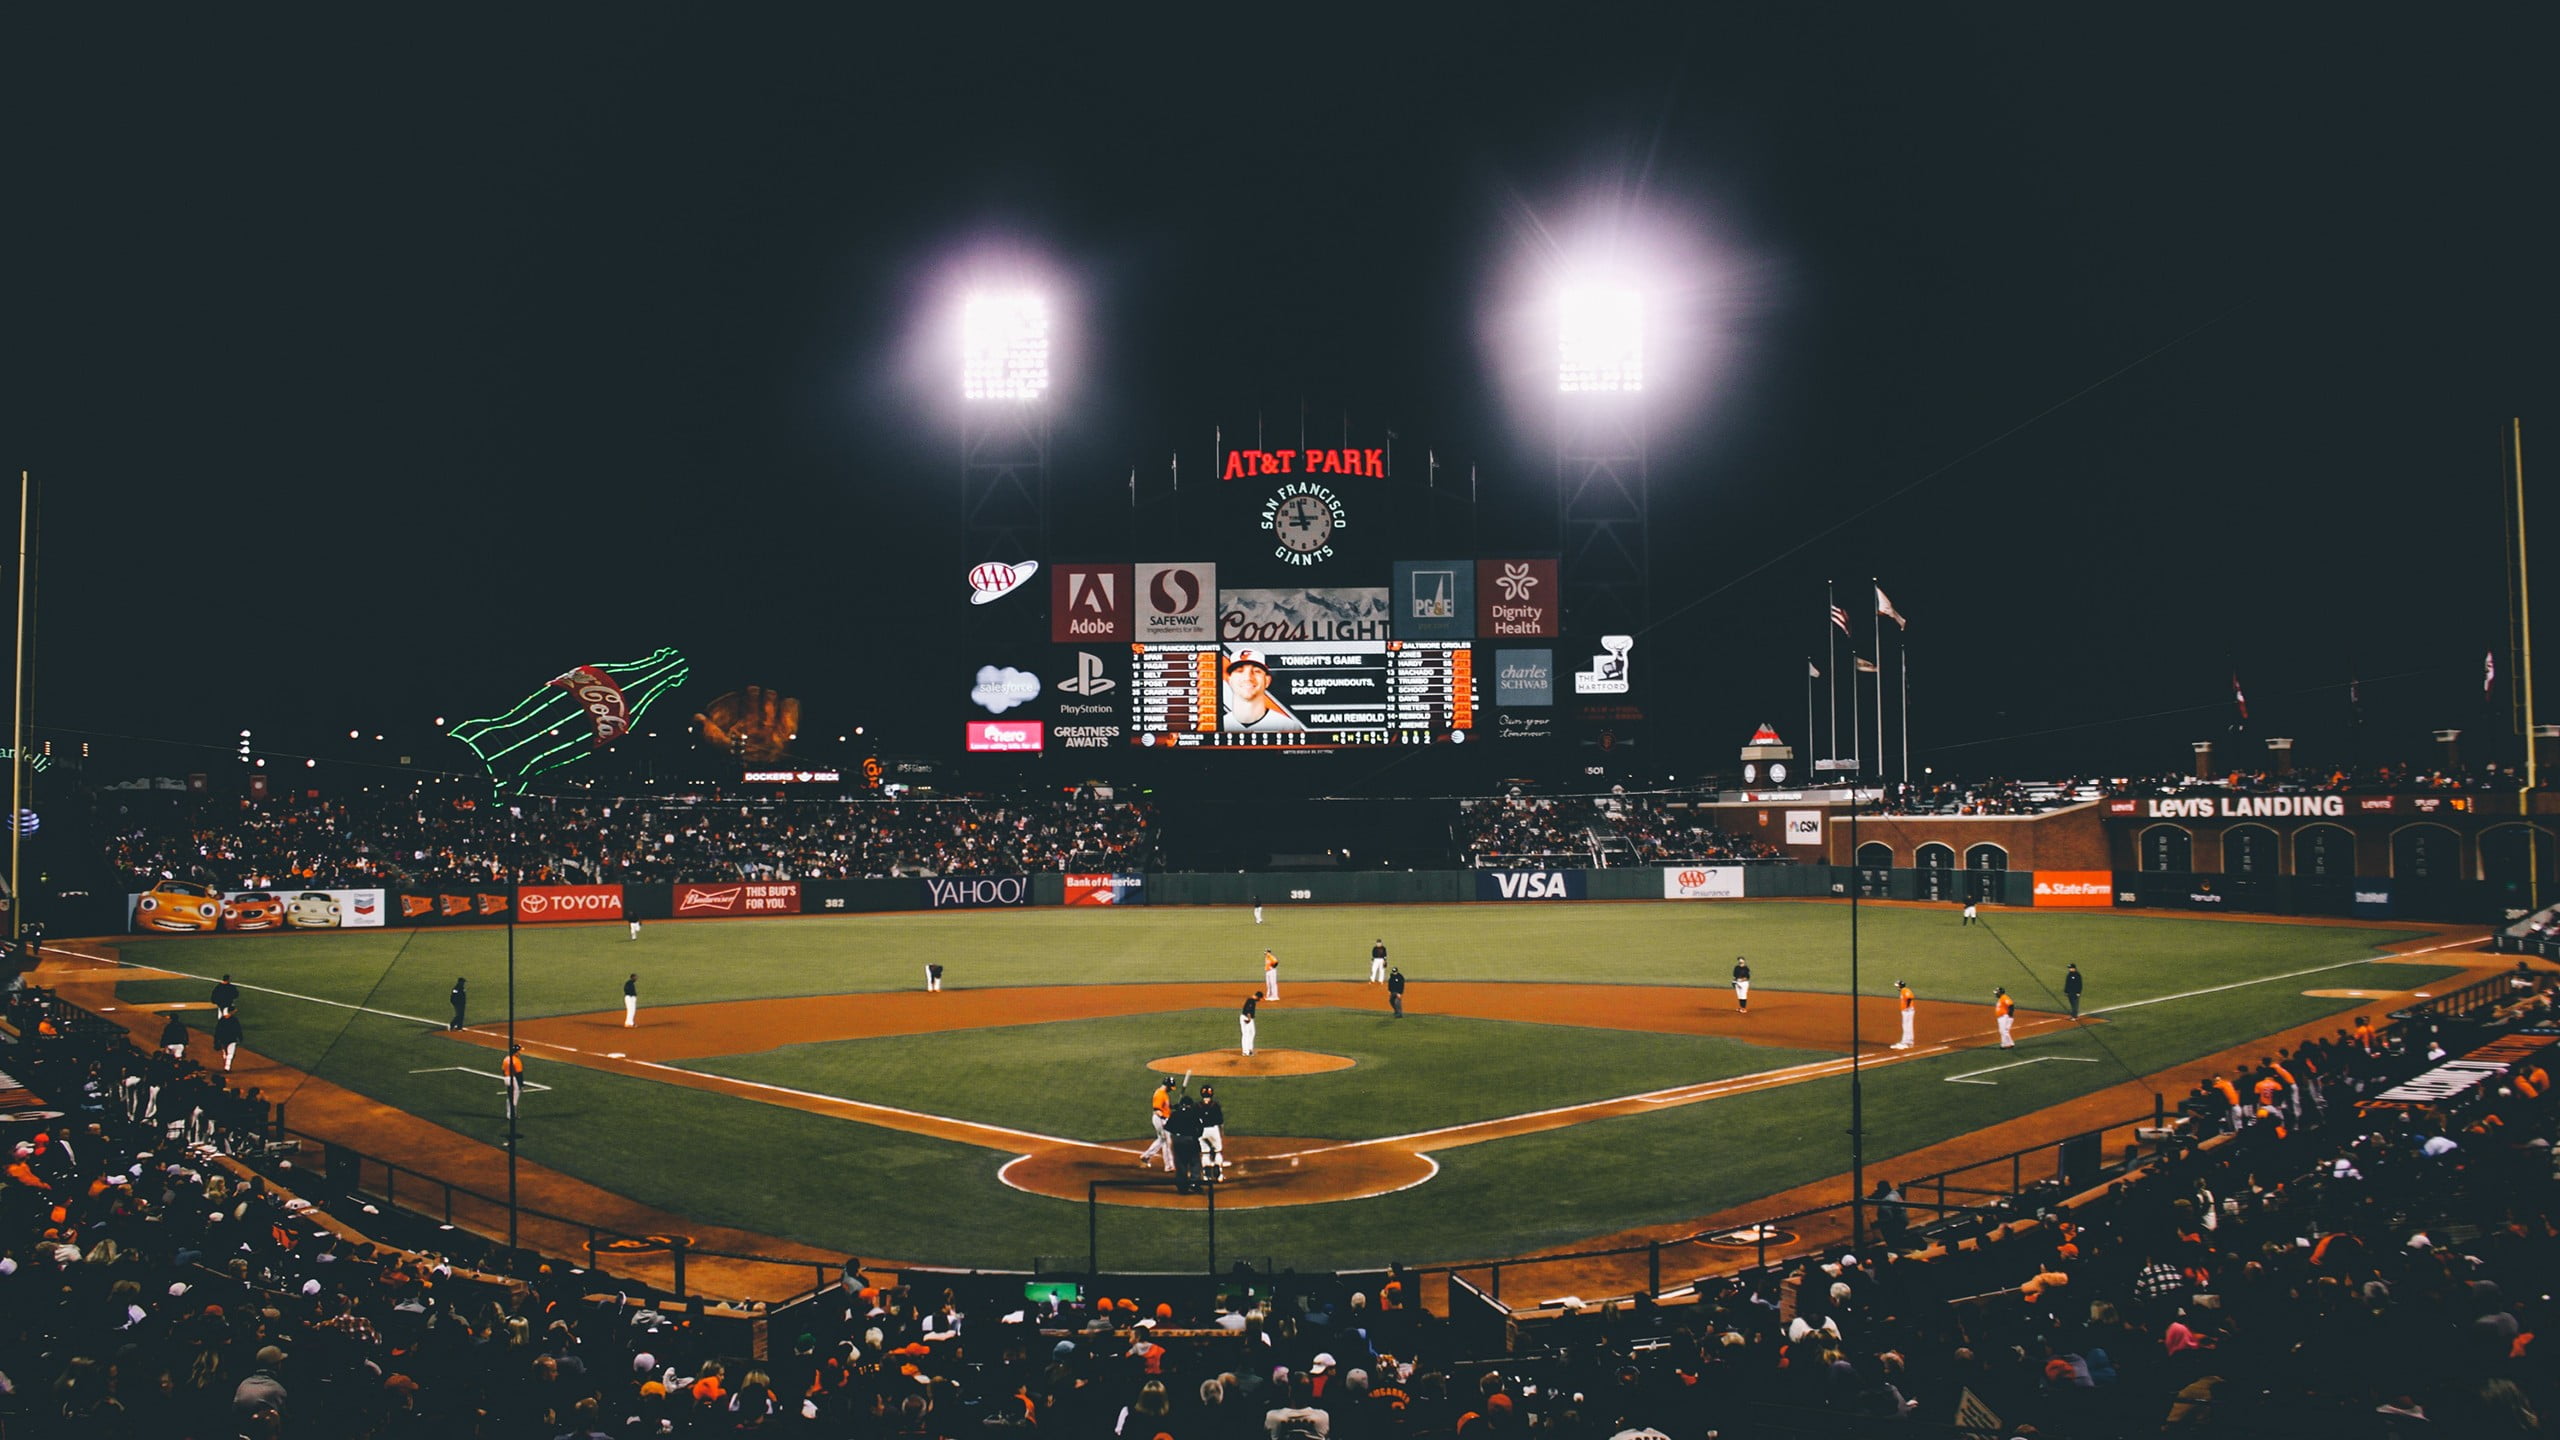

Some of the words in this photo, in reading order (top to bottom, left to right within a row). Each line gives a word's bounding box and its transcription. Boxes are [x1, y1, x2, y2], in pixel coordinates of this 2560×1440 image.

[1223, 449, 1297, 480] AT&T
[1304, 448, 1385, 479] PARK
[1261, 497, 1279, 529] SAN
[1277, 481, 1346, 528] FRANCISCO
[1275, 545, 1334, 565] GIANTS
[976, 564, 1013, 592] AAA
[1415, 599, 1452, 617] PG&E
[1492, 605, 1542, 621] Dignity
[1069, 618, 1114, 634] Adobe
[1150, 616, 1199, 626] SAFEWAY
[1222, 611, 1308, 640] Coors
[1313, 621, 1390, 640] LIGHT
[1495, 621, 1540, 634] Health
[1280, 656, 1331, 665] TONIGHT'S
[1333, 655, 1362, 665] GAME
[1501, 665, 1546, 679] charles
[980, 681, 1033, 695] salesforce
[1314, 678, 1375, 687] GROUNDOUTS,
[1501, 679, 1548, 689] SCHWAB
[1291, 687, 1326, 695] POPOUT
[579, 685, 628, 739] Cola
[1060, 704, 1112, 715] PlayStation
[1310, 714, 1342, 722] NOLAN
[1344, 713, 1384, 722] REIMOLD
[1054, 726, 1119, 737] GREATNESS
[1065, 737, 1109, 748] AWAITS
[745, 772, 794, 781] DOCKERS
[813, 772, 839, 781] DECK
[2221, 796, 2344, 817] LANDING
[1800, 821, 1818, 832] CSN
[1067, 877, 1091, 887] Bank
[1091, 877, 1103, 887] of
[1103, 877, 1141, 887] America
[1492, 872, 1567, 898] VISA
[1680, 870, 1704, 888] AAA
[746, 886, 767, 896] THIS
[768, 885, 796, 896] BUD'S
[927, 877, 1027, 907] YAHOO!
[1290, 890, 1311, 899] 399
[2051, 883, 2081, 895] State
[2082, 883, 2111, 895] Farm
[551, 895, 622, 910] TOYOTA
[686, 894, 736, 904] Budweiser
[746, 899, 764, 909] FOR
[766, 898, 787, 909] YOU.
[825, 898, 844, 908] 382
